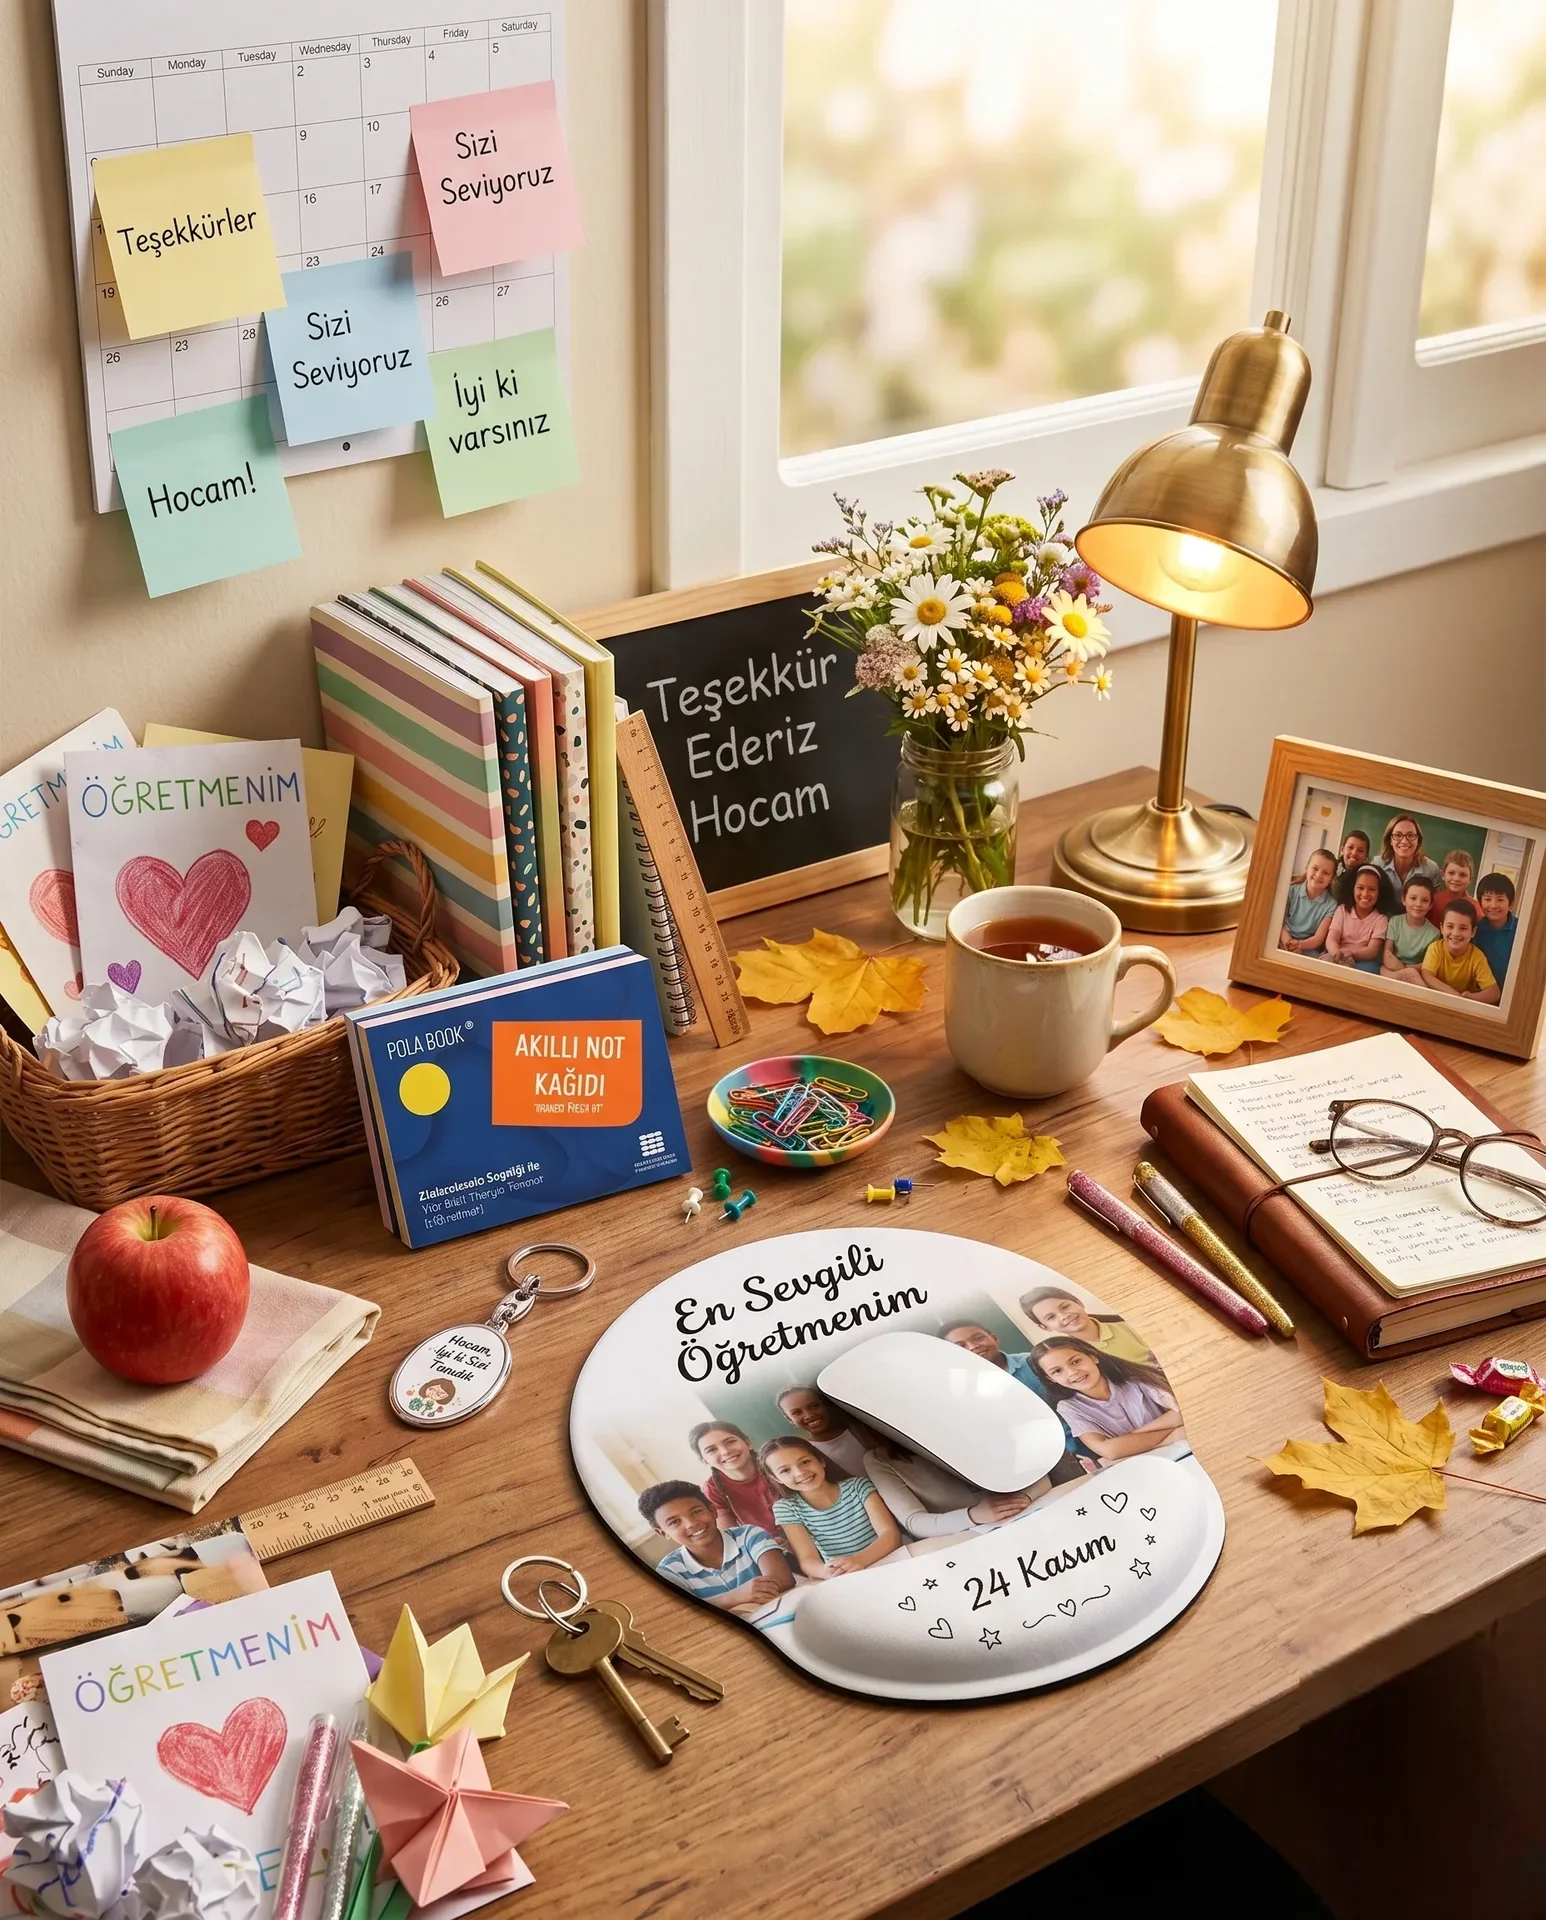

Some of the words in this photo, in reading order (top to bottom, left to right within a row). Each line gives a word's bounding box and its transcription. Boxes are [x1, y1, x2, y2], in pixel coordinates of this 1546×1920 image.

[97, 67, 134, 79] Sunday
[168, 58, 206, 71] Monday
[237, 50, 276, 63] Tuesday
[299, 42, 351, 56] Wednesday
[371, 35, 411, 48] Thursday
[443, 28, 469, 39] Friday
[501, 20, 538, 33] Saturday
[297, 66, 304, 77] 2
[364, 58, 371, 69] 3
[428, 50, 435, 61] 4
[492, 43, 499, 54] 5
[300, 130, 307, 141] 9
[367, 121, 380, 132] 10
[455, 129, 498, 159] Sizi
[304, 193, 317, 204] 16
[370, 184, 382, 195] 17
[440, 166, 554, 205] Seviyoruz
[117, 207, 257, 258] Teşekkürler
[101, 287, 115, 299] 19
[306, 256, 320, 267] 23
[371, 246, 384, 257] 24
[435, 295, 449, 307] 26
[497, 285, 510, 297] 27
[306, 309, 352, 340] Sizi
[106, 352, 121, 364] 26
[175, 340, 189, 352] 23
[242, 328, 256, 340] 28
[292, 348, 413, 389] Seviyoruz
[453, 372, 486, 416] İyi
[495, 368, 519, 399] ki
[449, 413, 551, 454] varsınız
[147, 461, 257, 518] Hocam!
[646, 647, 838, 723] Teşekkür
[686, 716, 819, 779] Ederiz
[81, 767, 301, 818] ÖĞRETMENİM
[690, 782, 830, 843] Hocam
[387, 1039, 424, 1060] POLA
[426, 1025, 465, 1052] BOOK
[515, 1034, 579, 1059] AKILLI
[586, 1036, 626, 1060] NOT
[535, 1067, 606, 1097] KAĞIDI
[674, 1297, 735, 1335] En
[742, 1244, 884, 1312] Sevgili
[448, 1334, 492, 1357] Hocam,
[677, 1286, 928, 1385] Öğretmenim
[276, 1512, 290, 1521] 21
[350, 1484, 365, 1495] 24
[963, 1566, 1011, 1611] 24
[1016, 1534, 1116, 1589] Kasım
[75, 1612, 342, 1713] ÖĞRETMENİM
